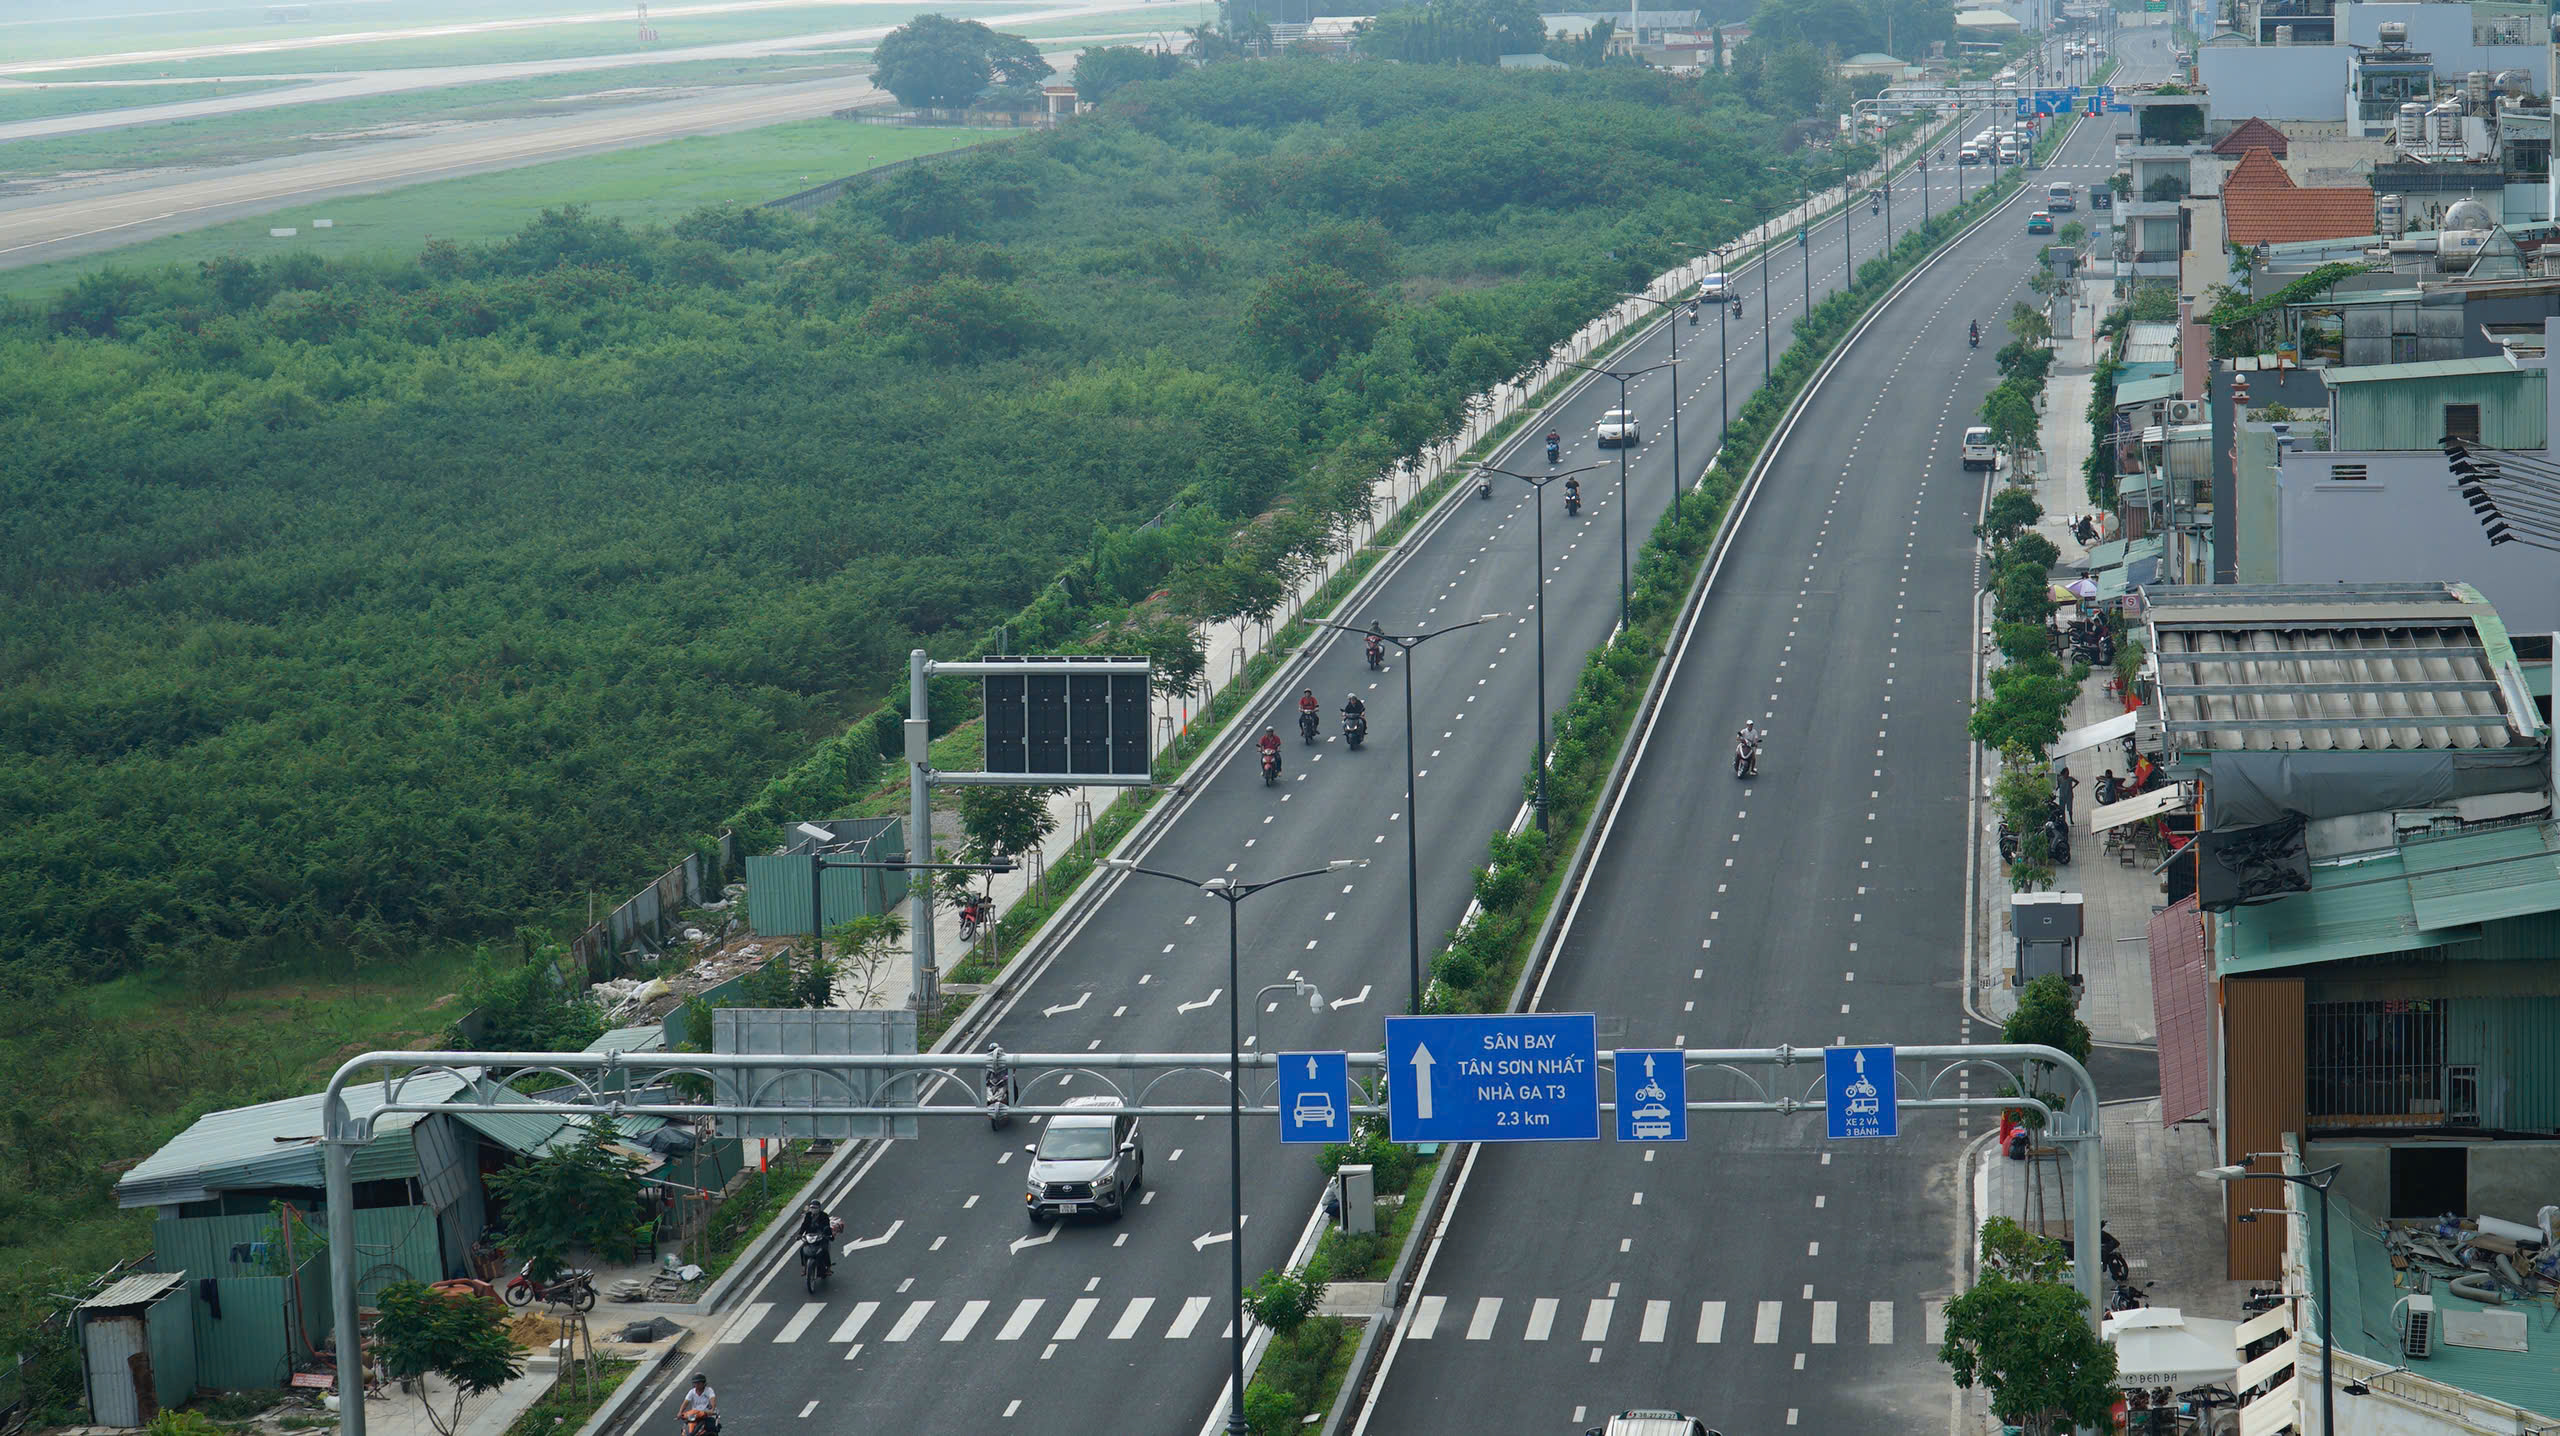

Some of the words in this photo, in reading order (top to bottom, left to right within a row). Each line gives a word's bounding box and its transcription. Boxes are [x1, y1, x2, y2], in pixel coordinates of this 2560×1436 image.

[1483, 1032, 1519, 1050] SÂN
[1524, 1034, 1556, 1049] BAY
[1457, 1058, 1493, 1076] TÂN
[1498, 1059, 1534, 1075] SƠN
[1537, 1053, 1585, 1074] NHẤT
[1478, 1082, 1515, 1101] NHÀ
[1519, 1085, 1542, 1100] GA
[1545, 1085, 1566, 1099] T3
[1496, 1111, 1520, 1126] 2.3
[1524, 1111, 1550, 1126] km
[1846, 1118, 1857, 1126] XE
[1859, 1118, 1865, 1126] 2
[1866, 1116, 1879, 1126] VÀ
[1846, 1128, 1851, 1136] 3
[1854, 1126, 1879, 1136] BÁNH
